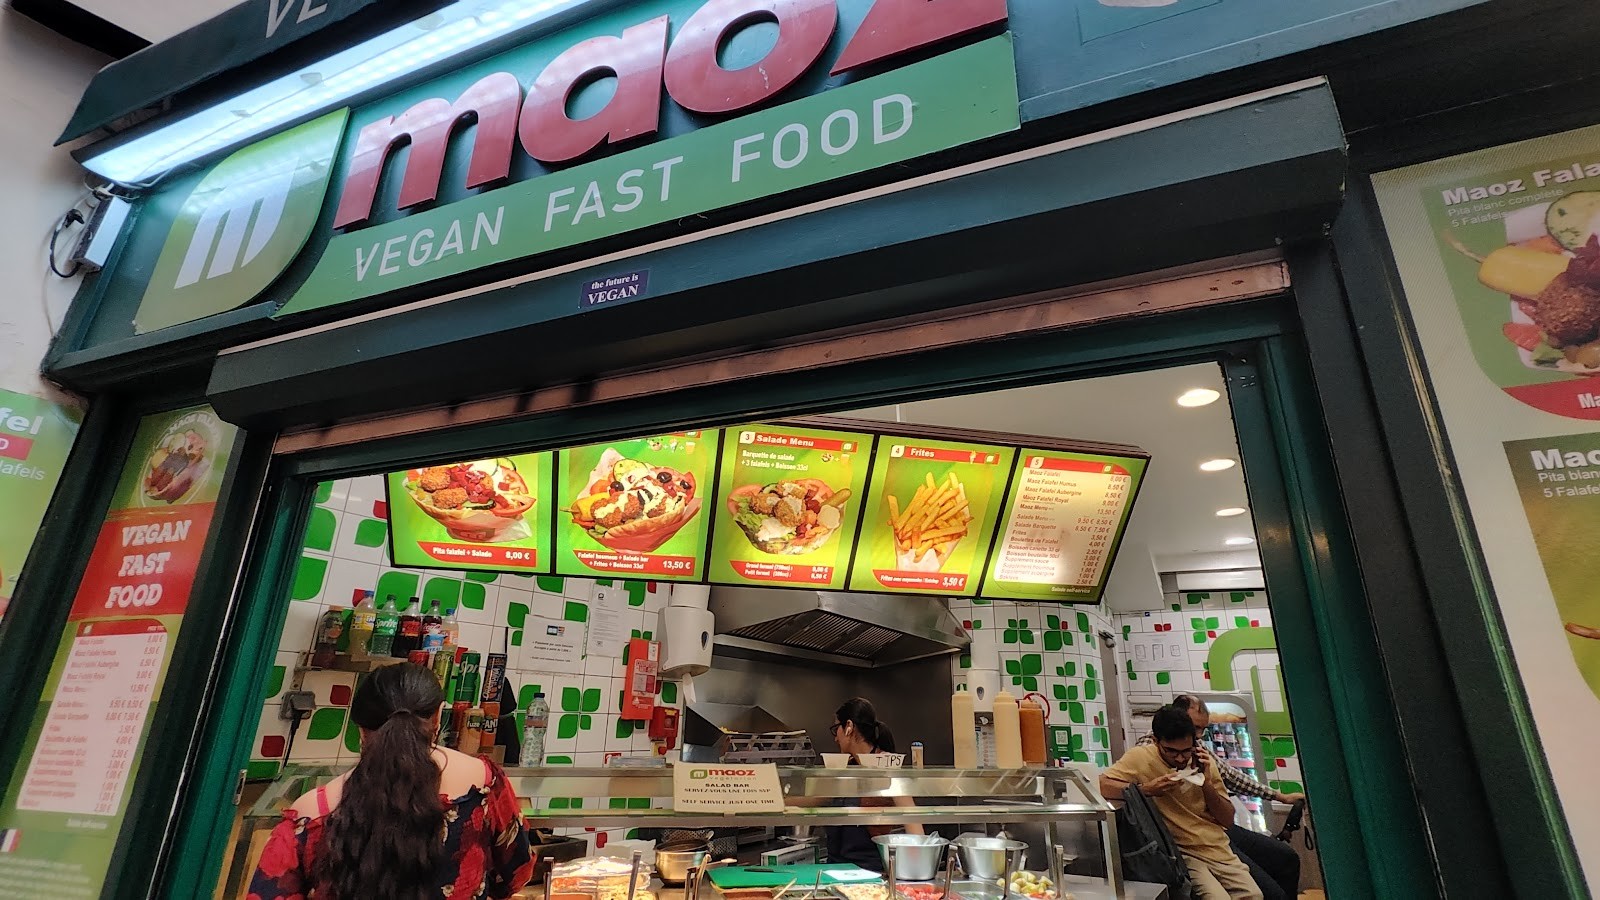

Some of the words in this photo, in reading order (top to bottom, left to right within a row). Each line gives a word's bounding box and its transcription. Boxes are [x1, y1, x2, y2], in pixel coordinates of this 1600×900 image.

[354, 206, 504, 283] VEGAN
[544, 155, 684, 234] FAST
[731, 92, 915, 184] FOOD
[1441, 178, 1526, 206] Maoz
[1448, 208, 1471, 217] Pita
[1473, 200, 1506, 212] blanc
[1451, 219, 1459, 228] 5
[1462, 210, 1509, 226] Falafels
[591, 281, 604, 290] the
[605, 276, 630, 286] future
[631, 273, 639, 282] is
[588, 284, 640, 305] VEGAN
[756, 434, 788, 445] Salade
[789, 437, 814, 447] Menu
[910, 448, 935, 457] Frites
[1538, 471, 1566, 482] Pita
[1543, 487, 1553, 498] 5
[121, 519, 192, 547] VEGAN
[505, 551, 522, 560] 8,00
[523, 552, 530, 560] €
[118, 552, 172, 577] FAST
[662, 560, 683, 570] 13,50
[942, 576, 957, 587] 3,50
[958, 577, 965, 586] €
[104, 584, 162, 609] FOOD
[375, 619, 398, 628] Sprite
[876, 754, 903, 767] TIPS
